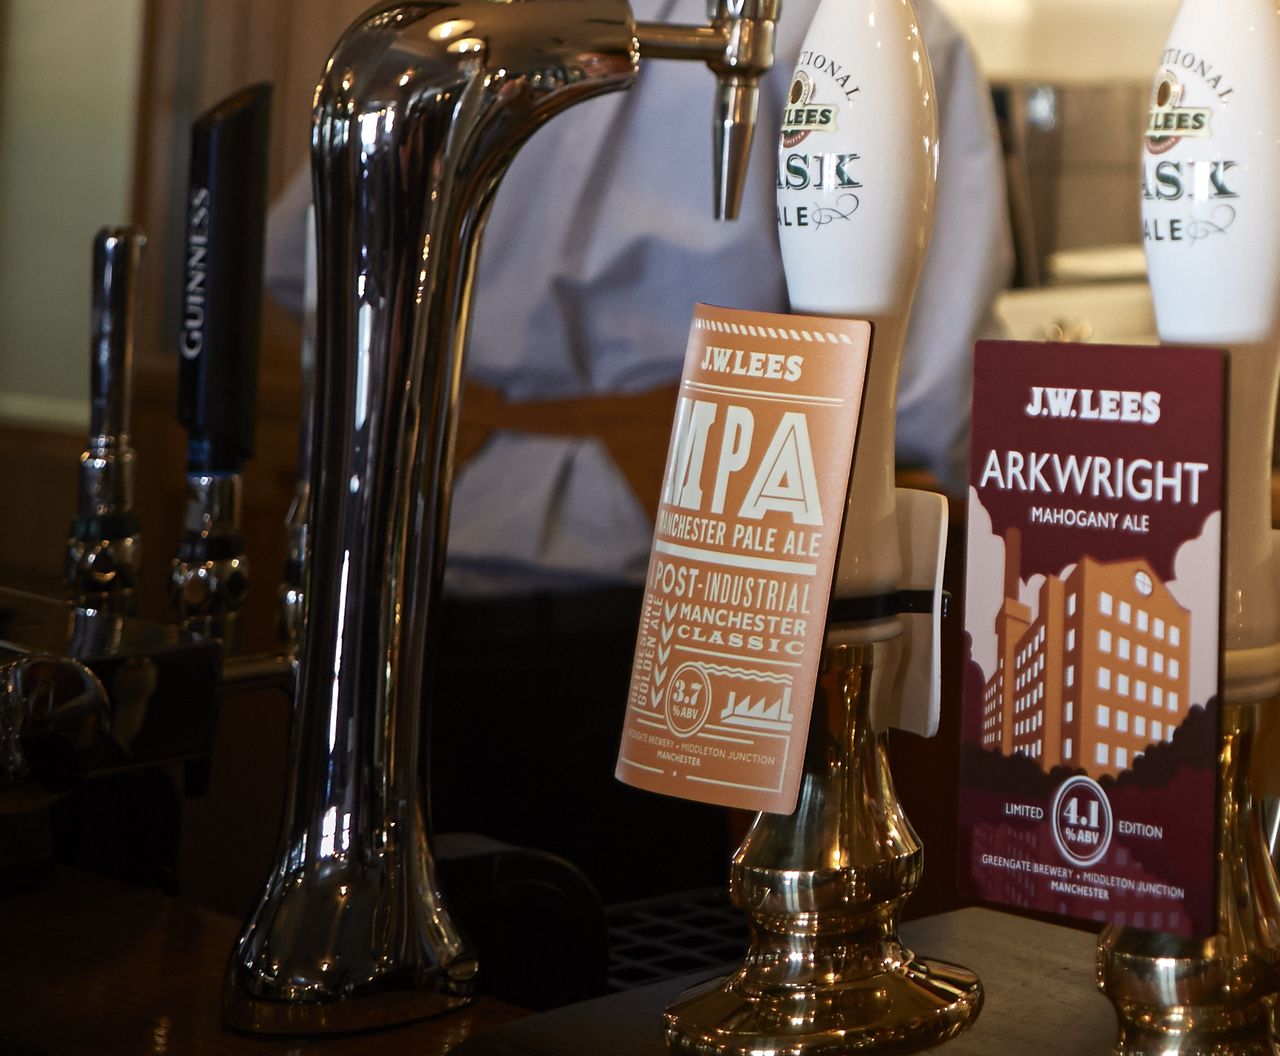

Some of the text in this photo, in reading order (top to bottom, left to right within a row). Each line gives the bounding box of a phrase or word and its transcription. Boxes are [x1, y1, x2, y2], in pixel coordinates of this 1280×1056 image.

[180, 187, 211, 360] GUINNESS
[701, 346, 803, 381] J.W.LEES
[1026, 386, 1162, 424] J.W.LEES
[664, 397, 823, 525] MPA
[981, 449, 1209, 505] ARKWRIGHT
[658, 510, 822, 557] MANCHESTER PALE ALE
[1031, 507, 1150, 532] MAHOGANY ALE
[656, 562, 810, 614] POST-INDUSTRIAL
[680, 604, 807, 637] MANCHESTER
[638, 598, 664, 705] GOLDEN ALE
[677, 625, 804, 655] CLASSIC
[672, 680, 703, 704] 3.7
[648, 736, 674, 749] BREWERY
[681, 744, 726, 758] MIDDLETON
[728, 752, 775, 765] JUNCTION
[657, 750, 701, 766] MANCHESTER
[1005, 803, 1163, 839] LIMITED EDITION
[1063, 797, 1100, 828] 4.1
[982, 854, 1185, 899] GREENGATE BREWERY MIDDLETON JUNCTION
[1050, 880, 1110, 900] MANCHESTER
